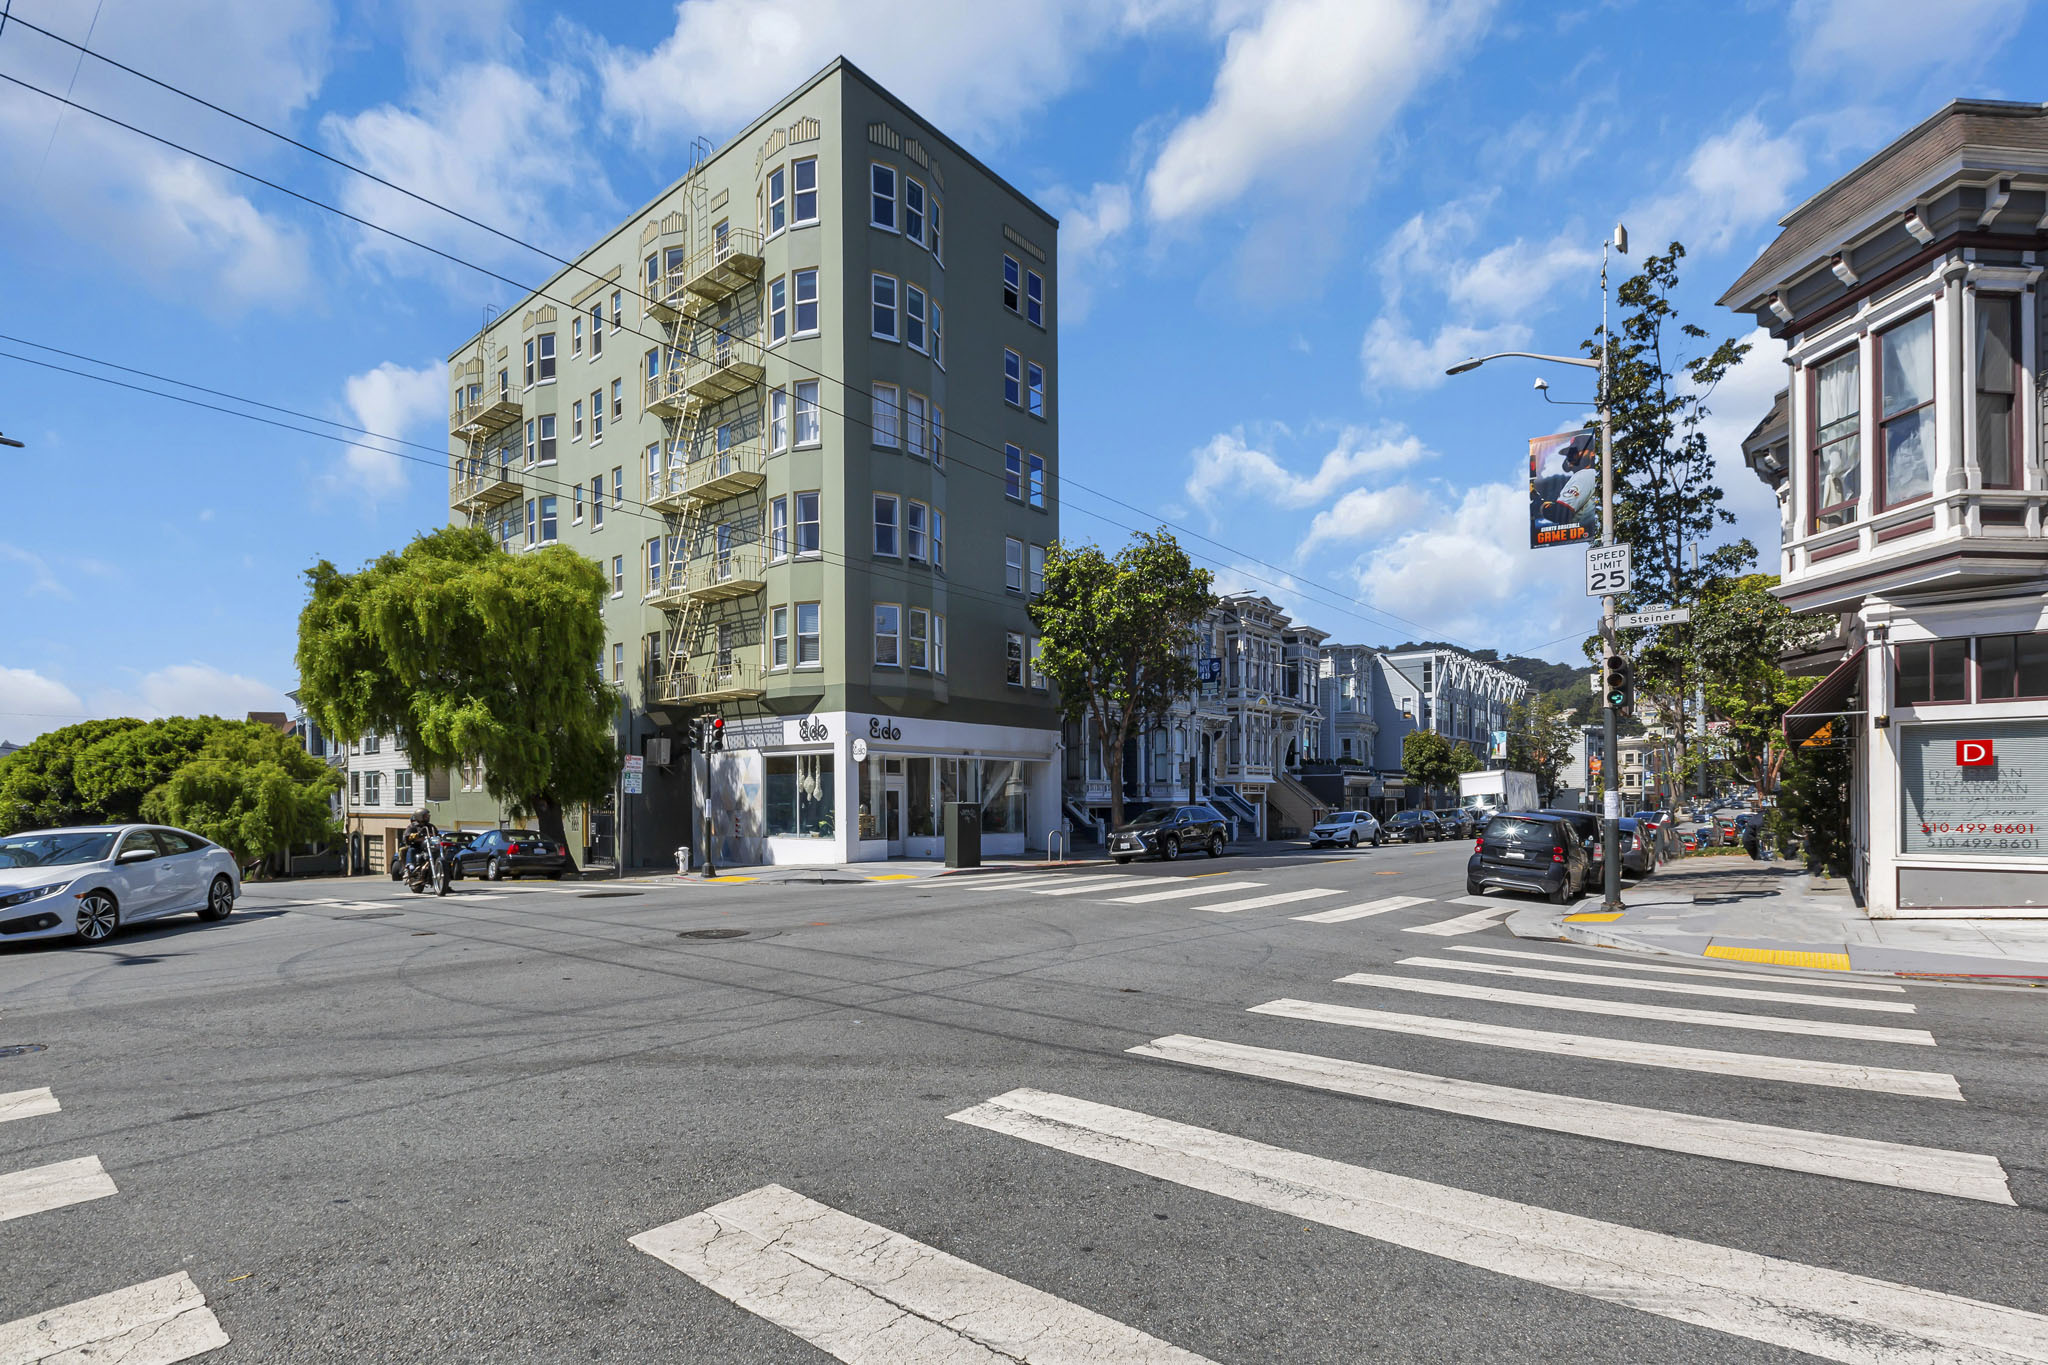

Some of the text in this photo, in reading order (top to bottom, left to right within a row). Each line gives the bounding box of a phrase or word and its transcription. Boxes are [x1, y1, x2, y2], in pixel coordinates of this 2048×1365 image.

[1537, 527, 1585, 544] GAME UP
[1590, 550, 1626, 561] SPEED
[1593, 559, 1622, 571] LIMIT
[1591, 570, 1626, 590] 25
[1630, 613, 1676, 624] Steiner
[1963, 743, 1986, 762] D
[1920, 822, 2035, 834] 510-499-8601
